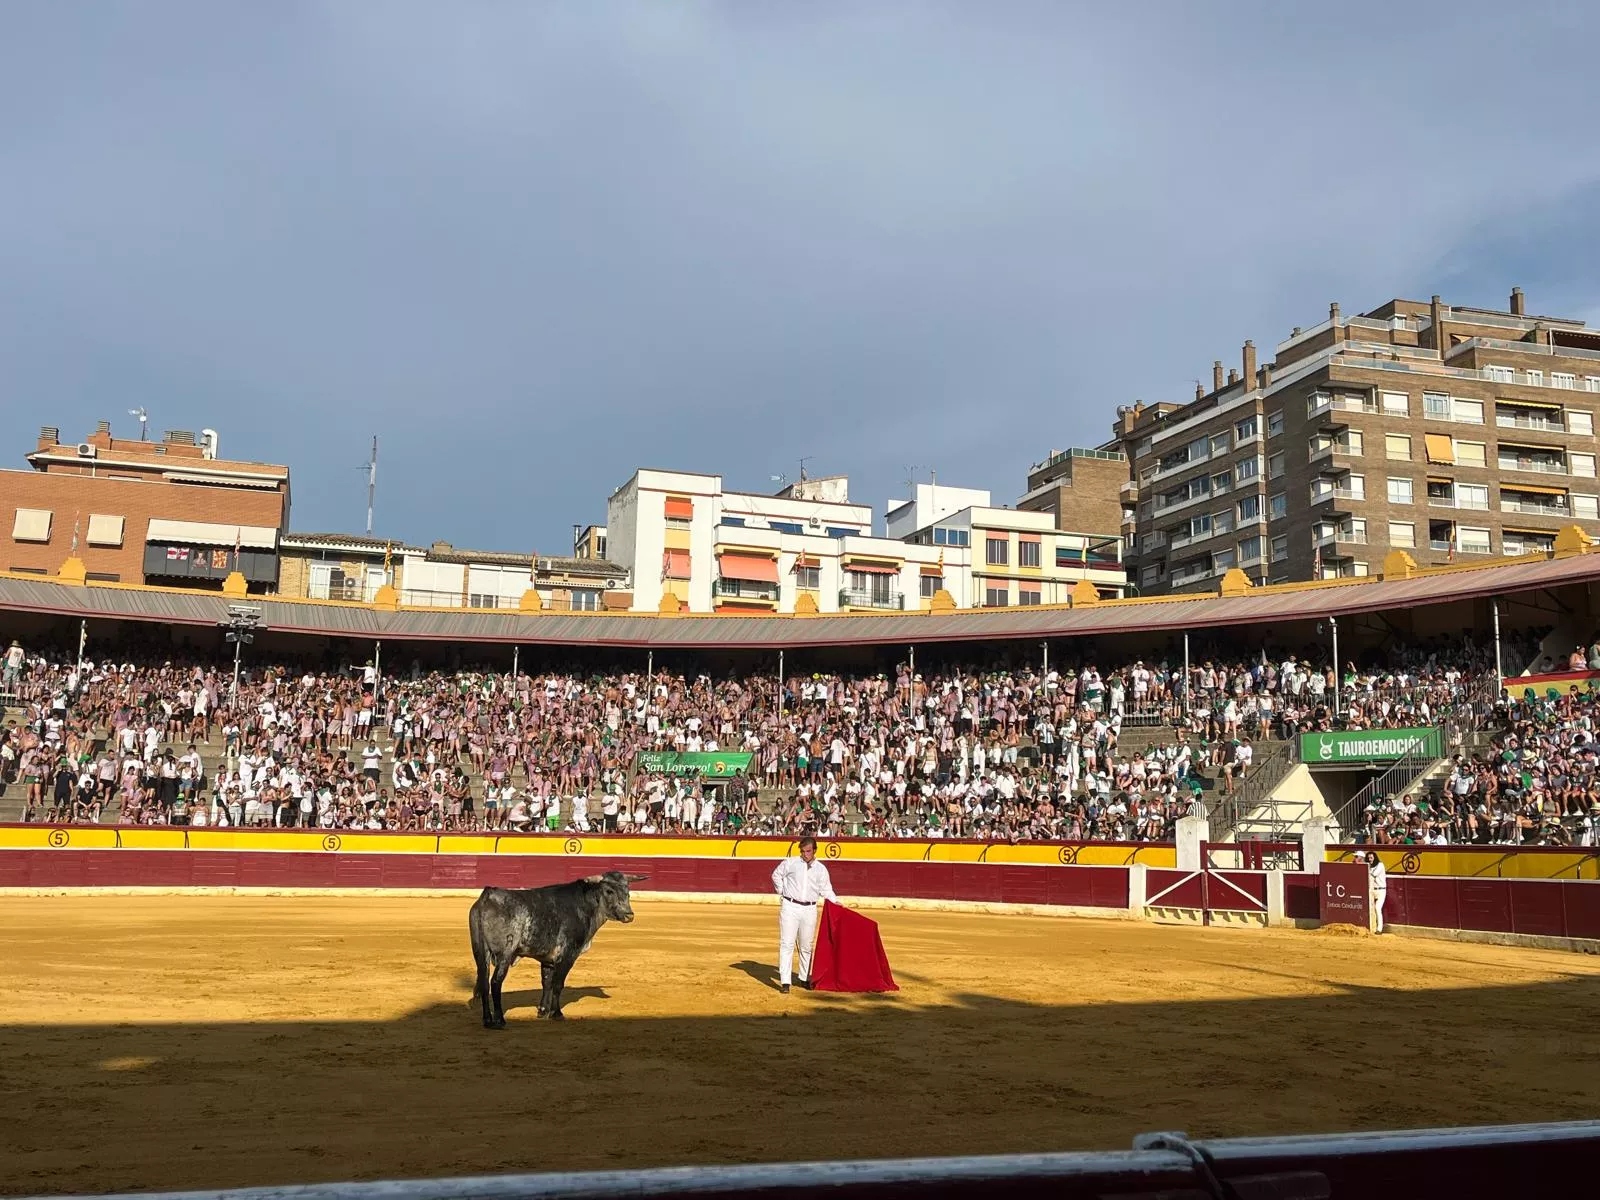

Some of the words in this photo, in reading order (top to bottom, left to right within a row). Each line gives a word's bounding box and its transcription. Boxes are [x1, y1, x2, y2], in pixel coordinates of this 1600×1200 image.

[1338, 735, 1424, 757] TAUROEMOCIÓN
[645, 763, 663, 772] San
[54, 833, 64, 845] 5
[328, 837, 336, 849] 5
[569, 841, 577, 853] 5
[829, 845, 837, 857] 5
[1063, 850, 1072, 862] 5
[1407, 856, 1415, 870] 6
